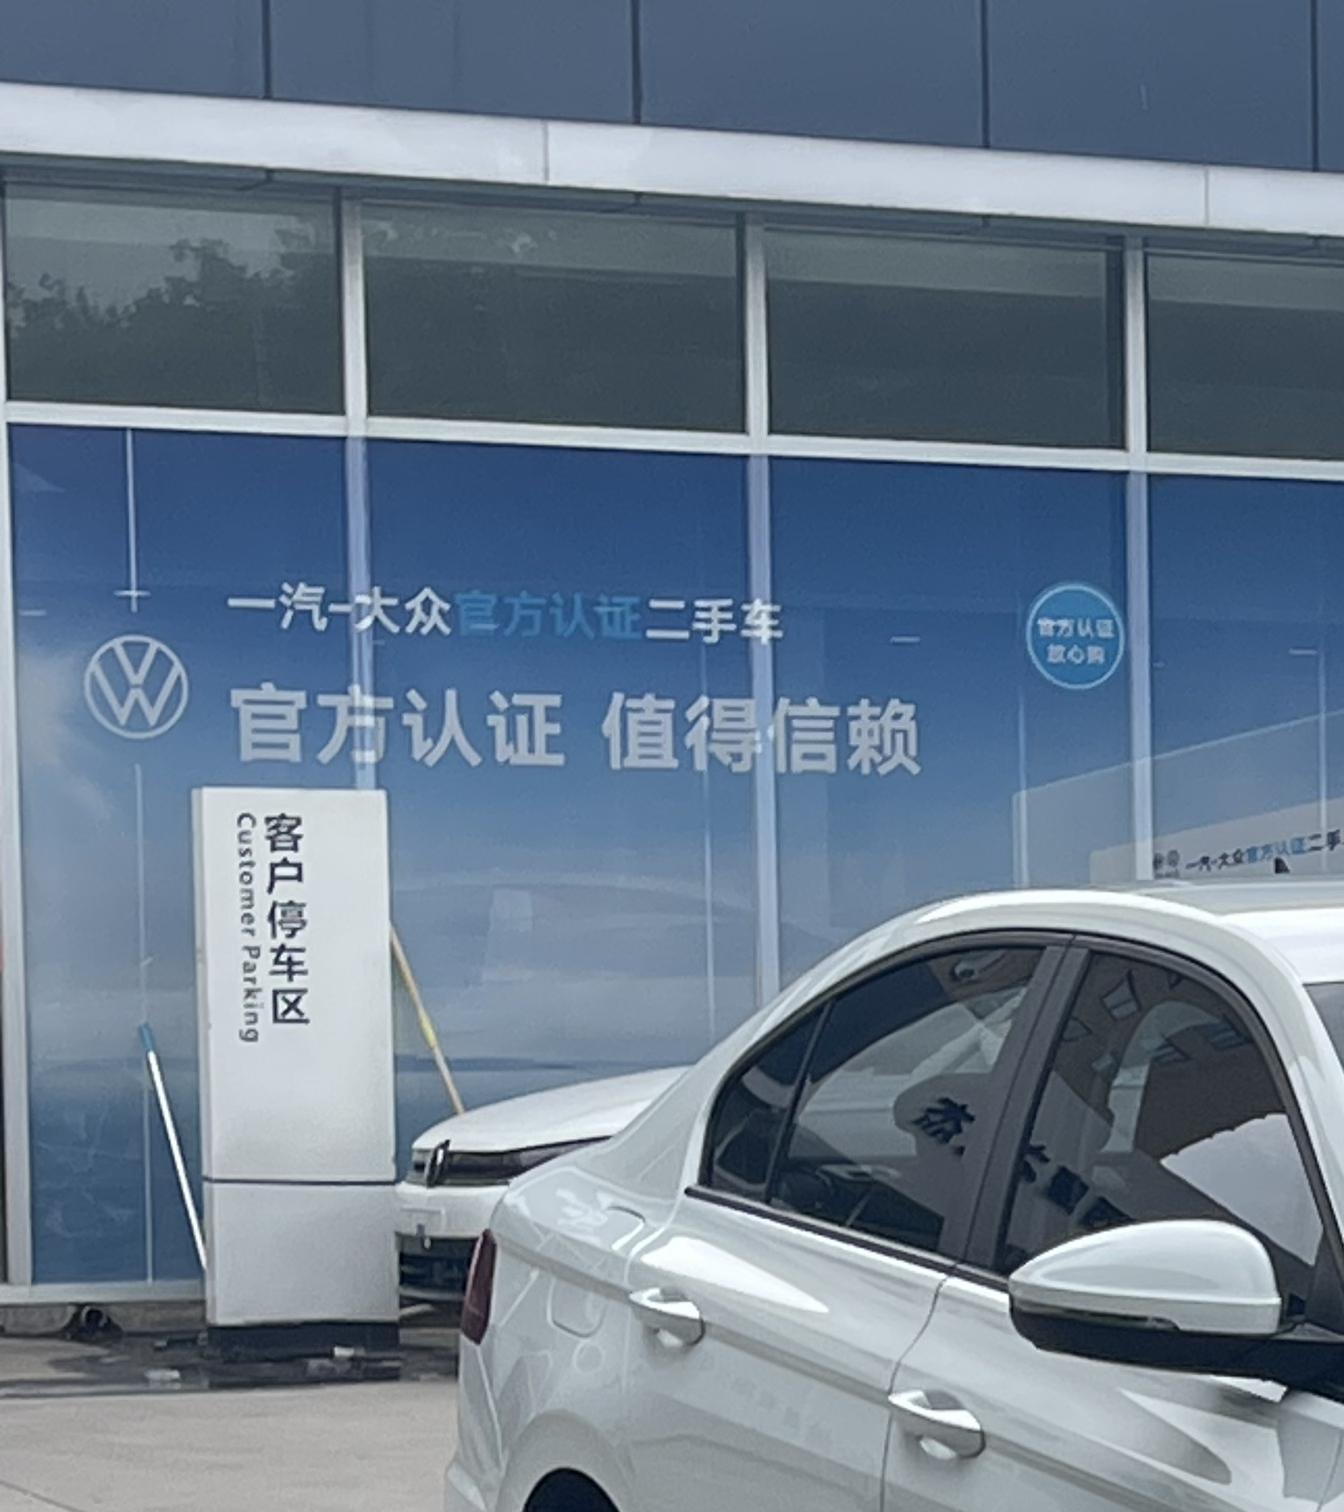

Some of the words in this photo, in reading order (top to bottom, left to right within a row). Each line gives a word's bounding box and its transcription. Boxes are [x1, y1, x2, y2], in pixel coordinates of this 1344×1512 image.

[226, 582, 784, 647] 一汽-大众官方认证二手车
[228, 683, 567, 769] 官方认证
[600, 690, 923, 779] 值得信赖
[236, 811, 257, 937] Customer
[263, 812, 311, 1025] 客户停车区
[239, 944, 264, 1043] Parking
